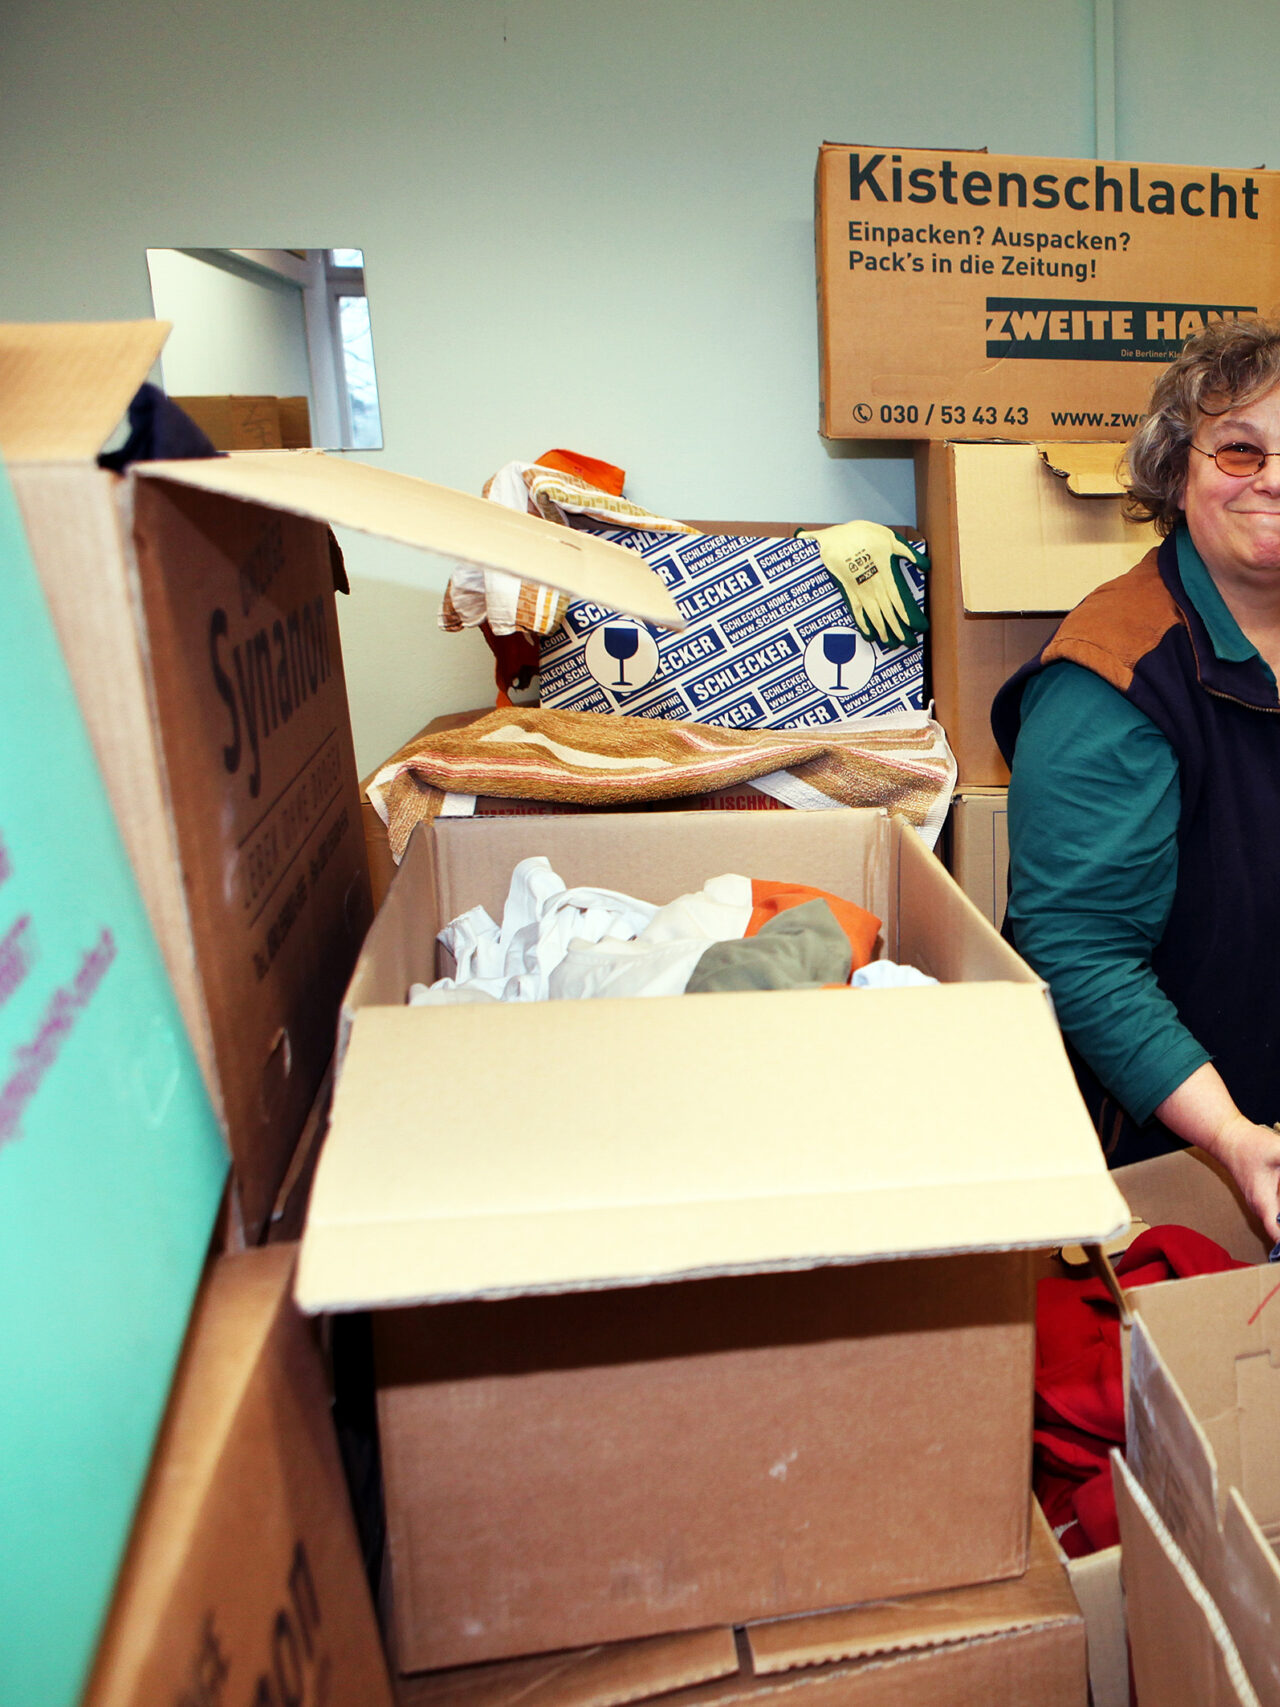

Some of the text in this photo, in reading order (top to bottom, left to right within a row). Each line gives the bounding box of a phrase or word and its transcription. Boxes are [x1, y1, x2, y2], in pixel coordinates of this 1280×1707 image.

[848, 153, 1259, 220] Kistenschlacht
[848, 221, 1131, 252] Einpacken? Auspacken?
[848, 251, 1098, 282] Pack's in die Zeitung!
[986, 310, 1257, 341] ZWEITE HA
[1121, 349, 1134, 357] Die
[1135, 349, 1167, 358] Berliner
[880, 404, 1029, 426] 030 / 53 43 43
[681, 535, 727, 564] SCHLECKER
[760, 540, 805, 569] SCHLECKER
[677, 570, 753, 621] HLECKER
[723, 605, 768, 634] SCHLECKER
[768, 592, 791, 611] HOME
[790, 571, 830, 598] SHOPPING
[729, 582, 834, 642] www.SCHLECKER.com
[799, 609, 844, 638] SCHLECKER
[693, 639, 793, 701] SCHLECKER
[880, 662, 904, 680] HOME
[209, 596, 332, 799] Synanon
[763, 672, 807, 700] SCHLECKER
